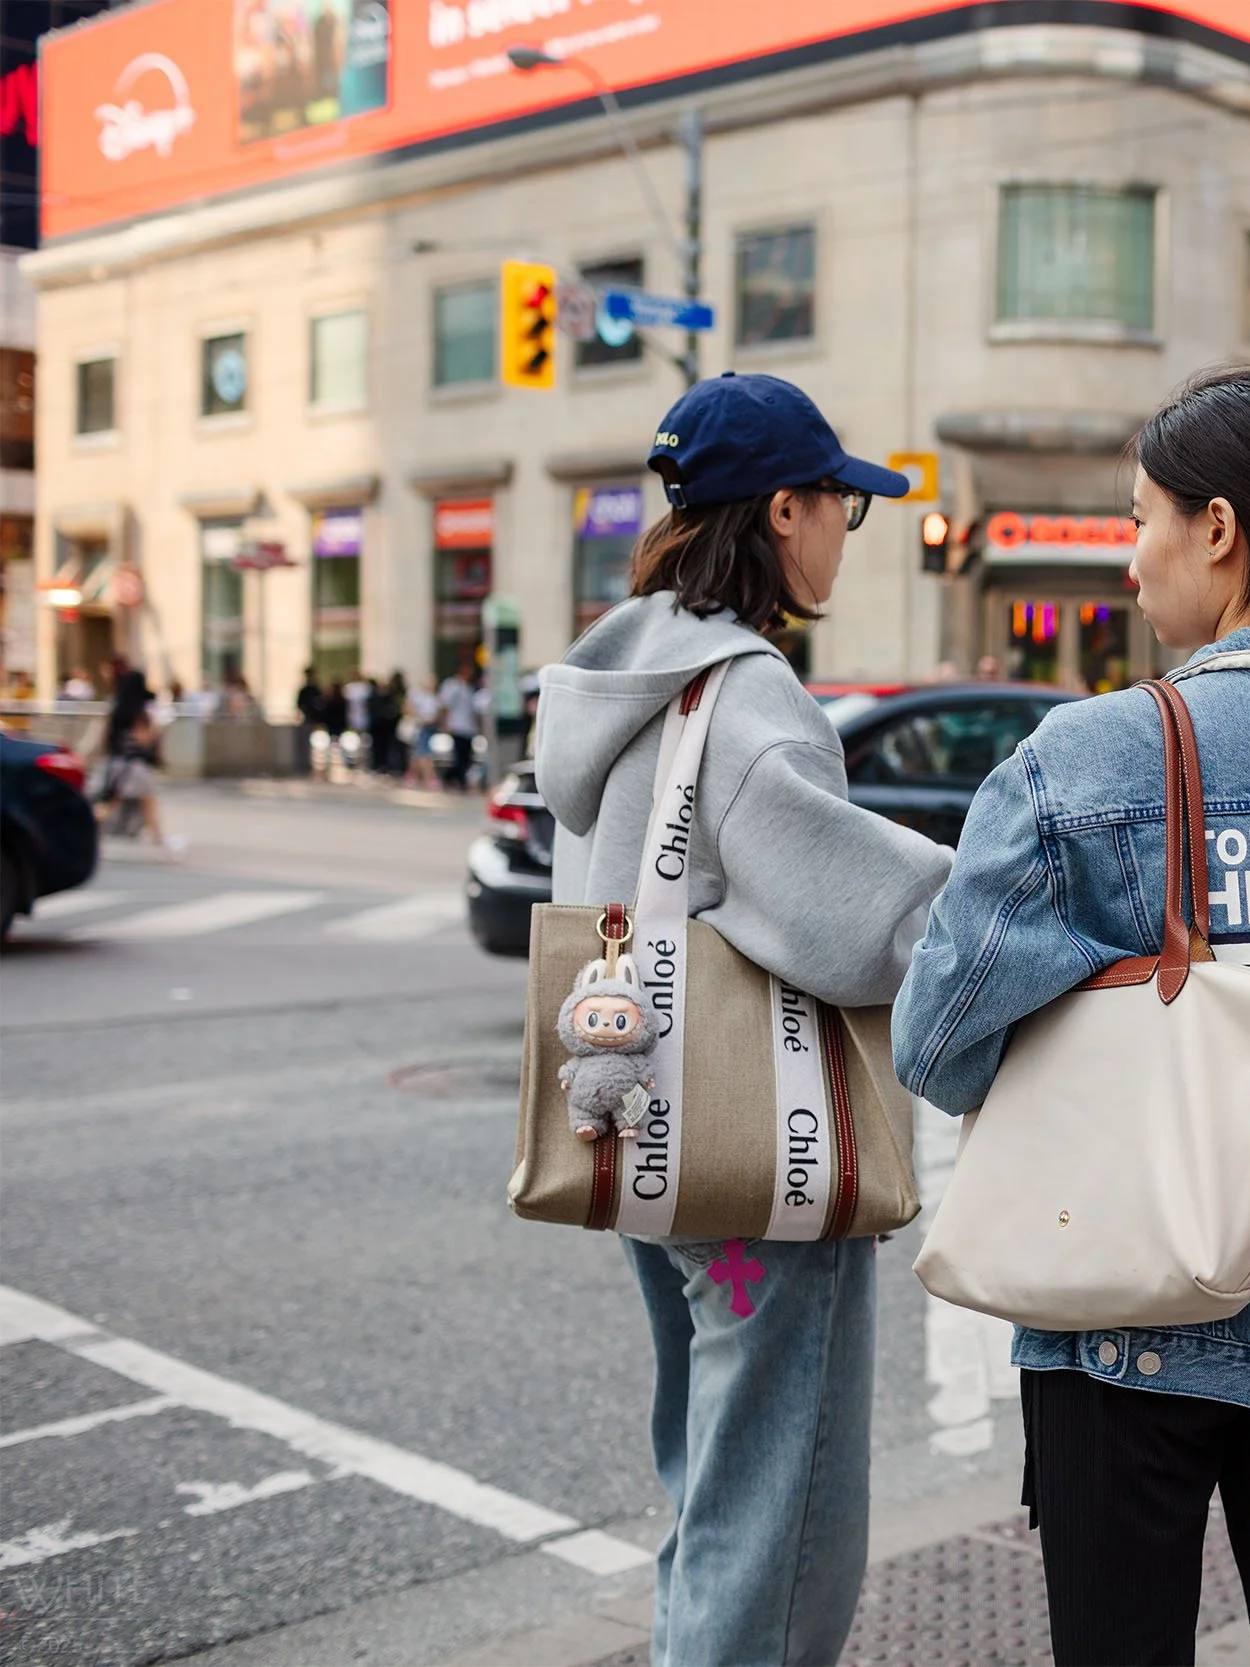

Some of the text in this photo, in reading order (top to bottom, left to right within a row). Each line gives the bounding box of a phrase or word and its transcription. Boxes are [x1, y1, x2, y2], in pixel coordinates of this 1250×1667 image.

[655, 784, 695, 881] Chloé
[781, 979, 809, 1052] hloé
[785, 1108, 819, 1207] Chloé
